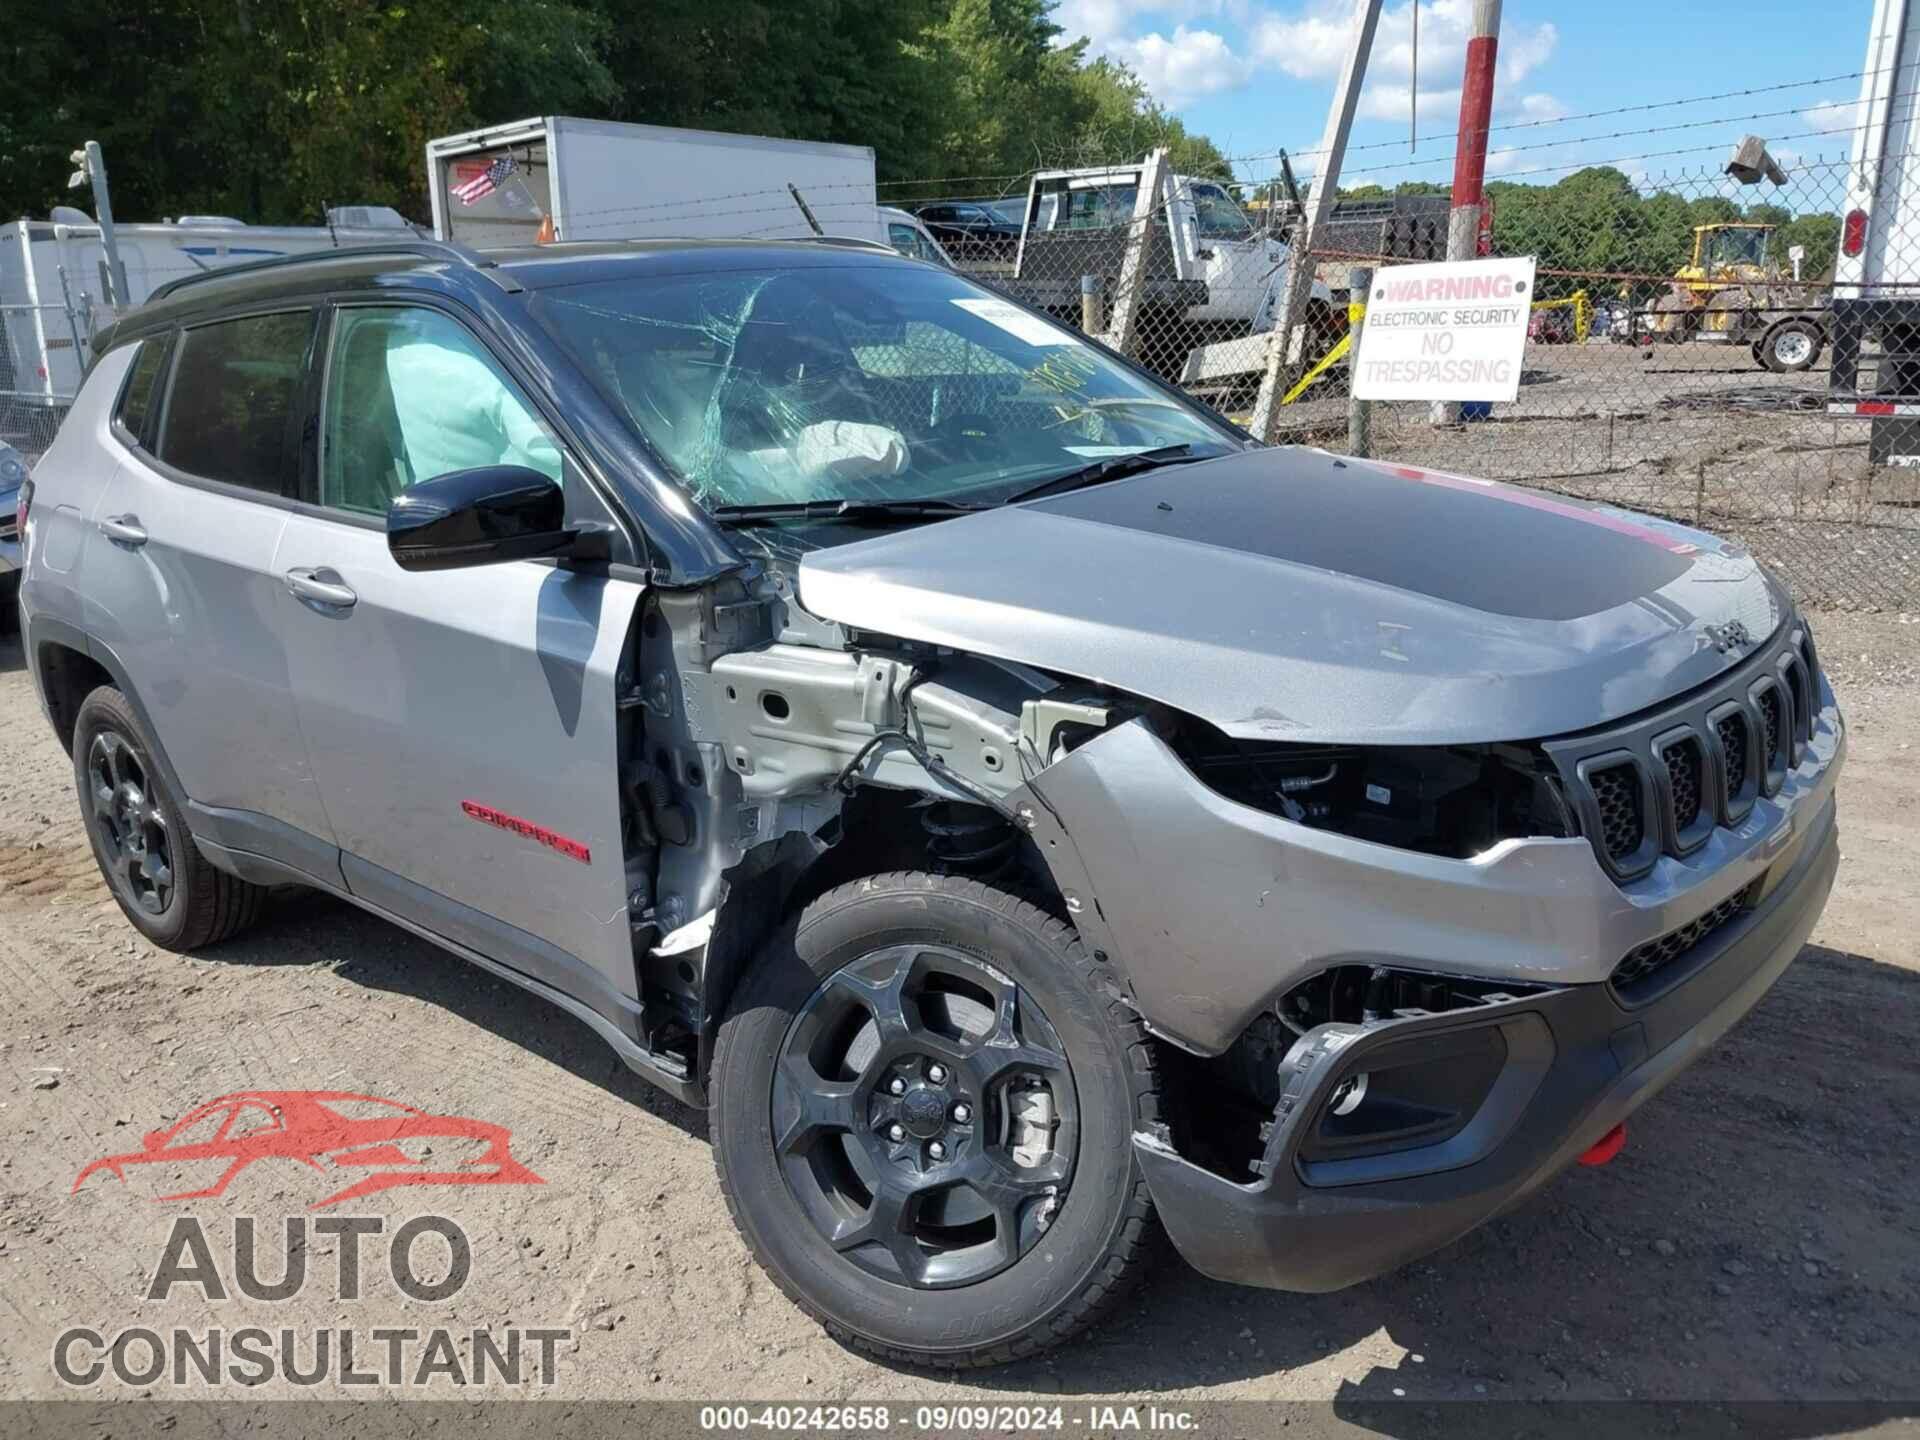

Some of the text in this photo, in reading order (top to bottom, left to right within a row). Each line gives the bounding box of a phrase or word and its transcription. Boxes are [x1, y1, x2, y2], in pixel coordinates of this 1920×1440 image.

[1386, 274, 1513, 302] WARNING
[1370, 308, 1520, 327] ELECTRONIC SECURITY
[1421, 331, 1454, 355] NO
[1364, 359, 1511, 384] TRESPASSING
